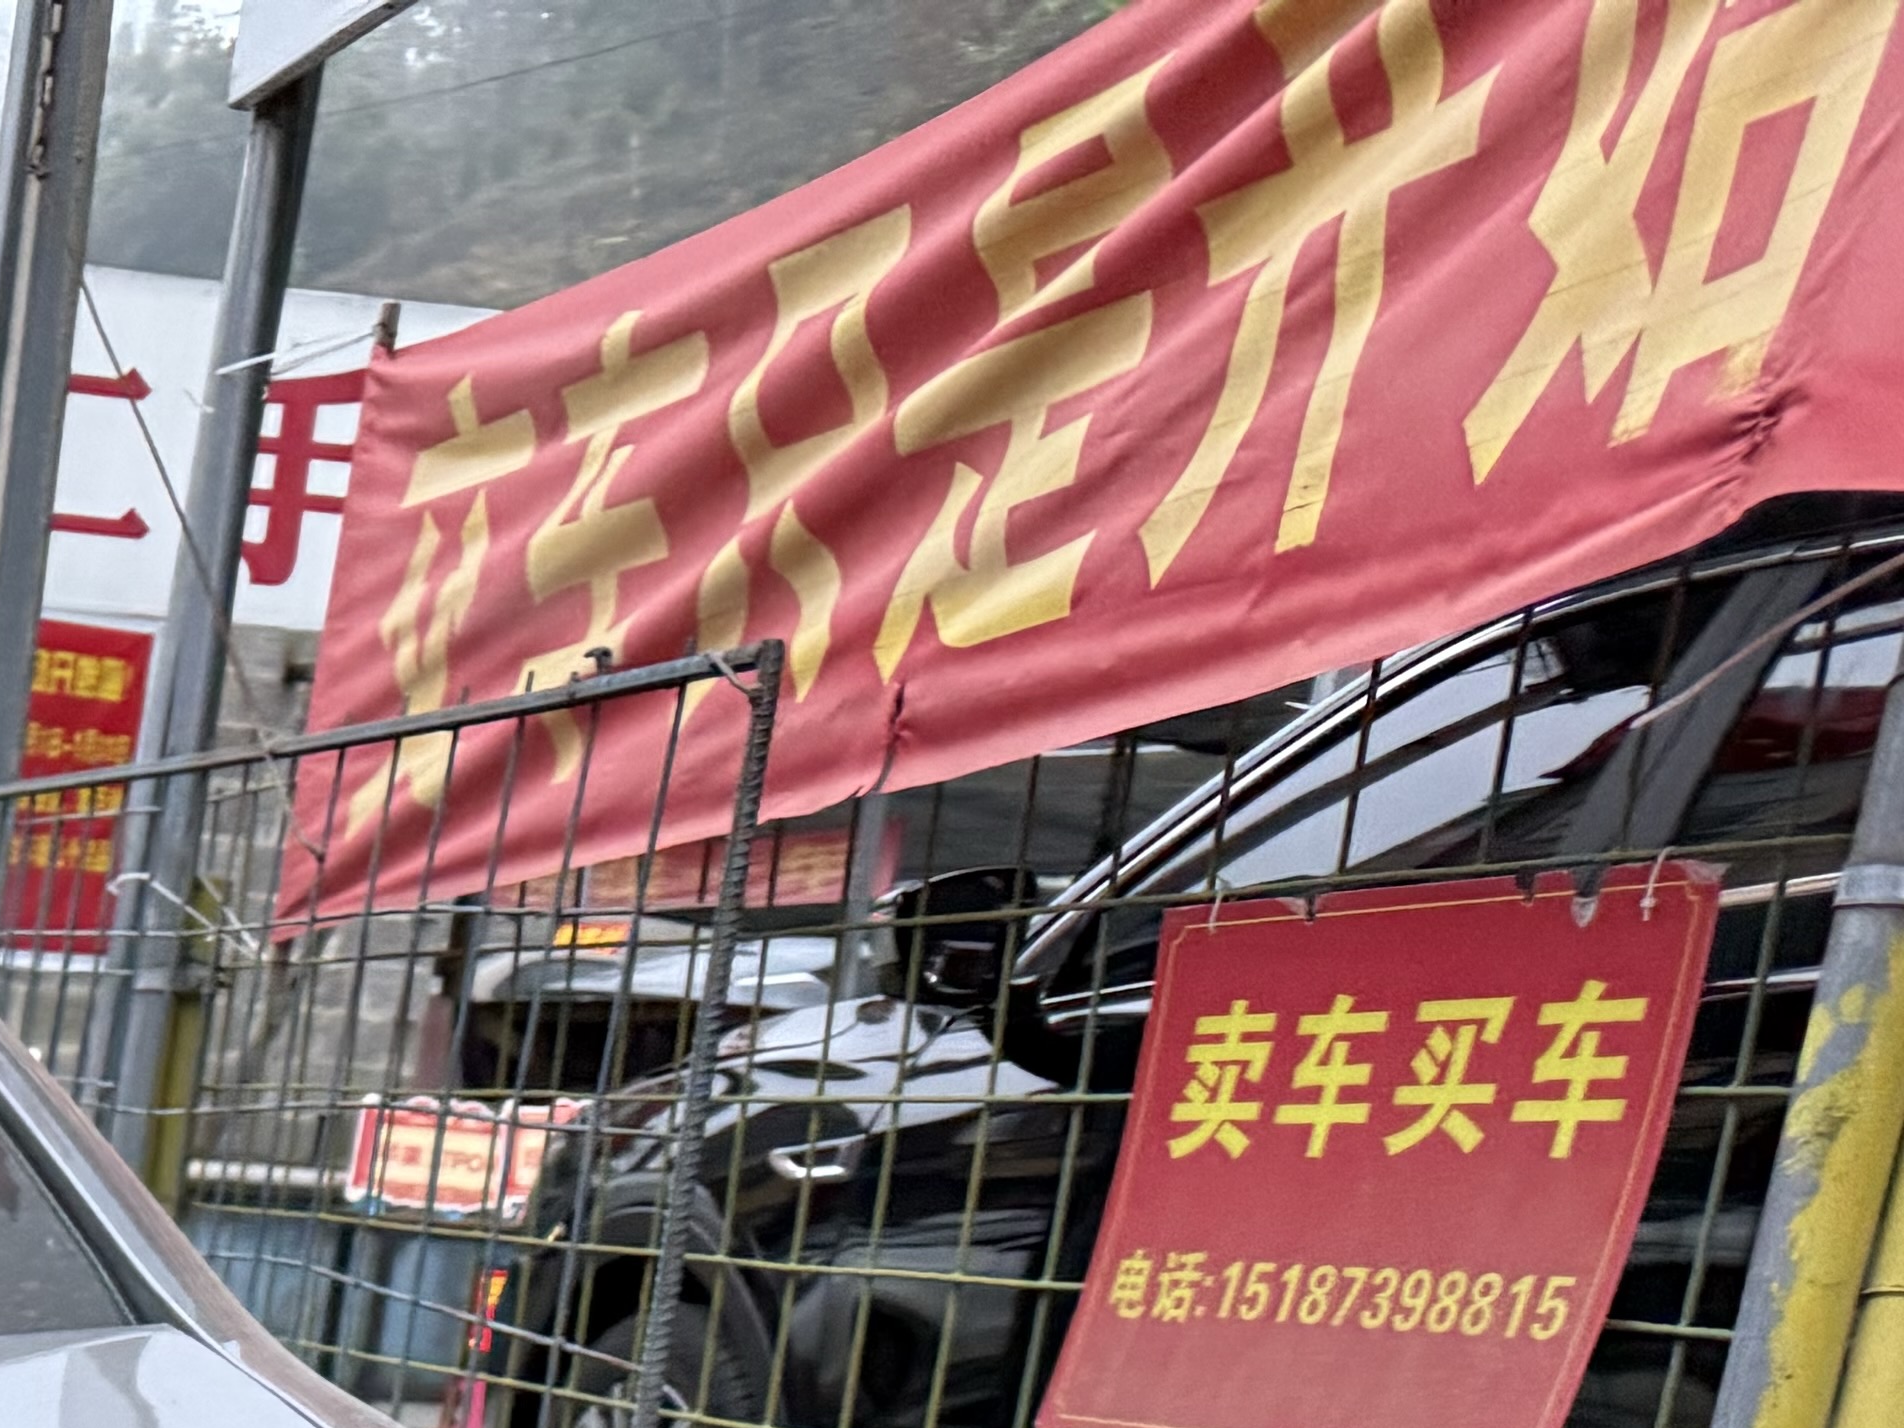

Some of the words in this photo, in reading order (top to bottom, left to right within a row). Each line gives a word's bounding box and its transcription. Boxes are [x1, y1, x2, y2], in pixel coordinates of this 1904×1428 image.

[1165, 978, 1650, 1159] 卖车买车
[1108, 1248, 1578, 1342] 电话:15187398815
